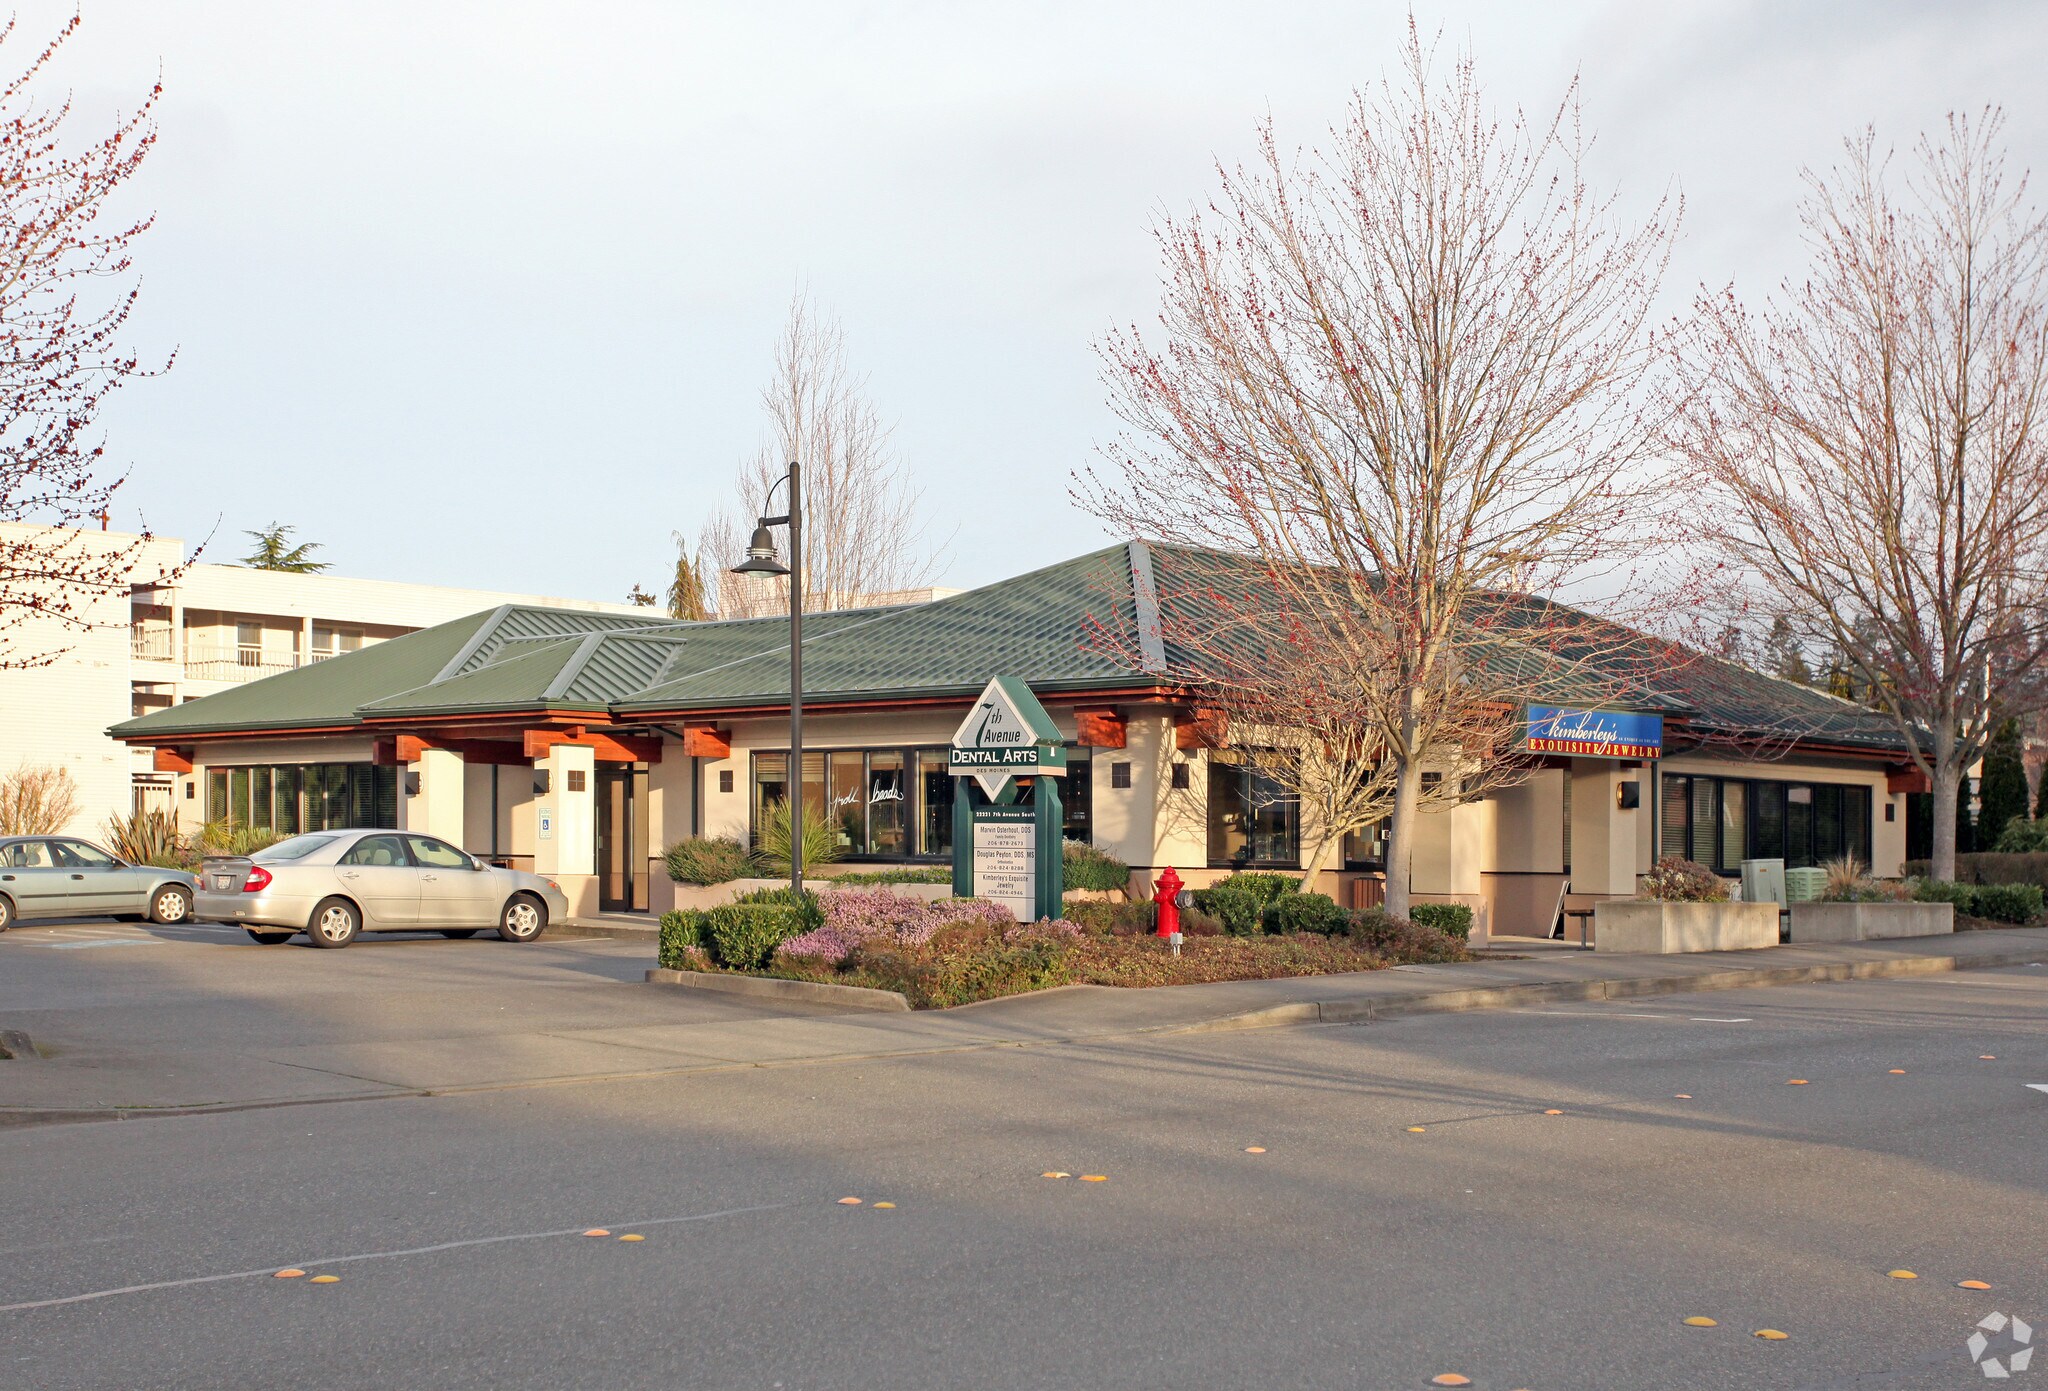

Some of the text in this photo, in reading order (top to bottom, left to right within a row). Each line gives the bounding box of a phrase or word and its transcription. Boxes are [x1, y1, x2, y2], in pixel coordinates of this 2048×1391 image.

[975, 702, 1002, 747] 7th
[984, 729, 1021, 743] Avenue
[1530, 738, 1661, 758] EXQUISITE JEWELRY
[952, 749, 1037, 763] DENTAL ARTS
[977, 850, 995, 858] Douglas
[983, 874, 1029, 882] Kimberley's Exquisite
